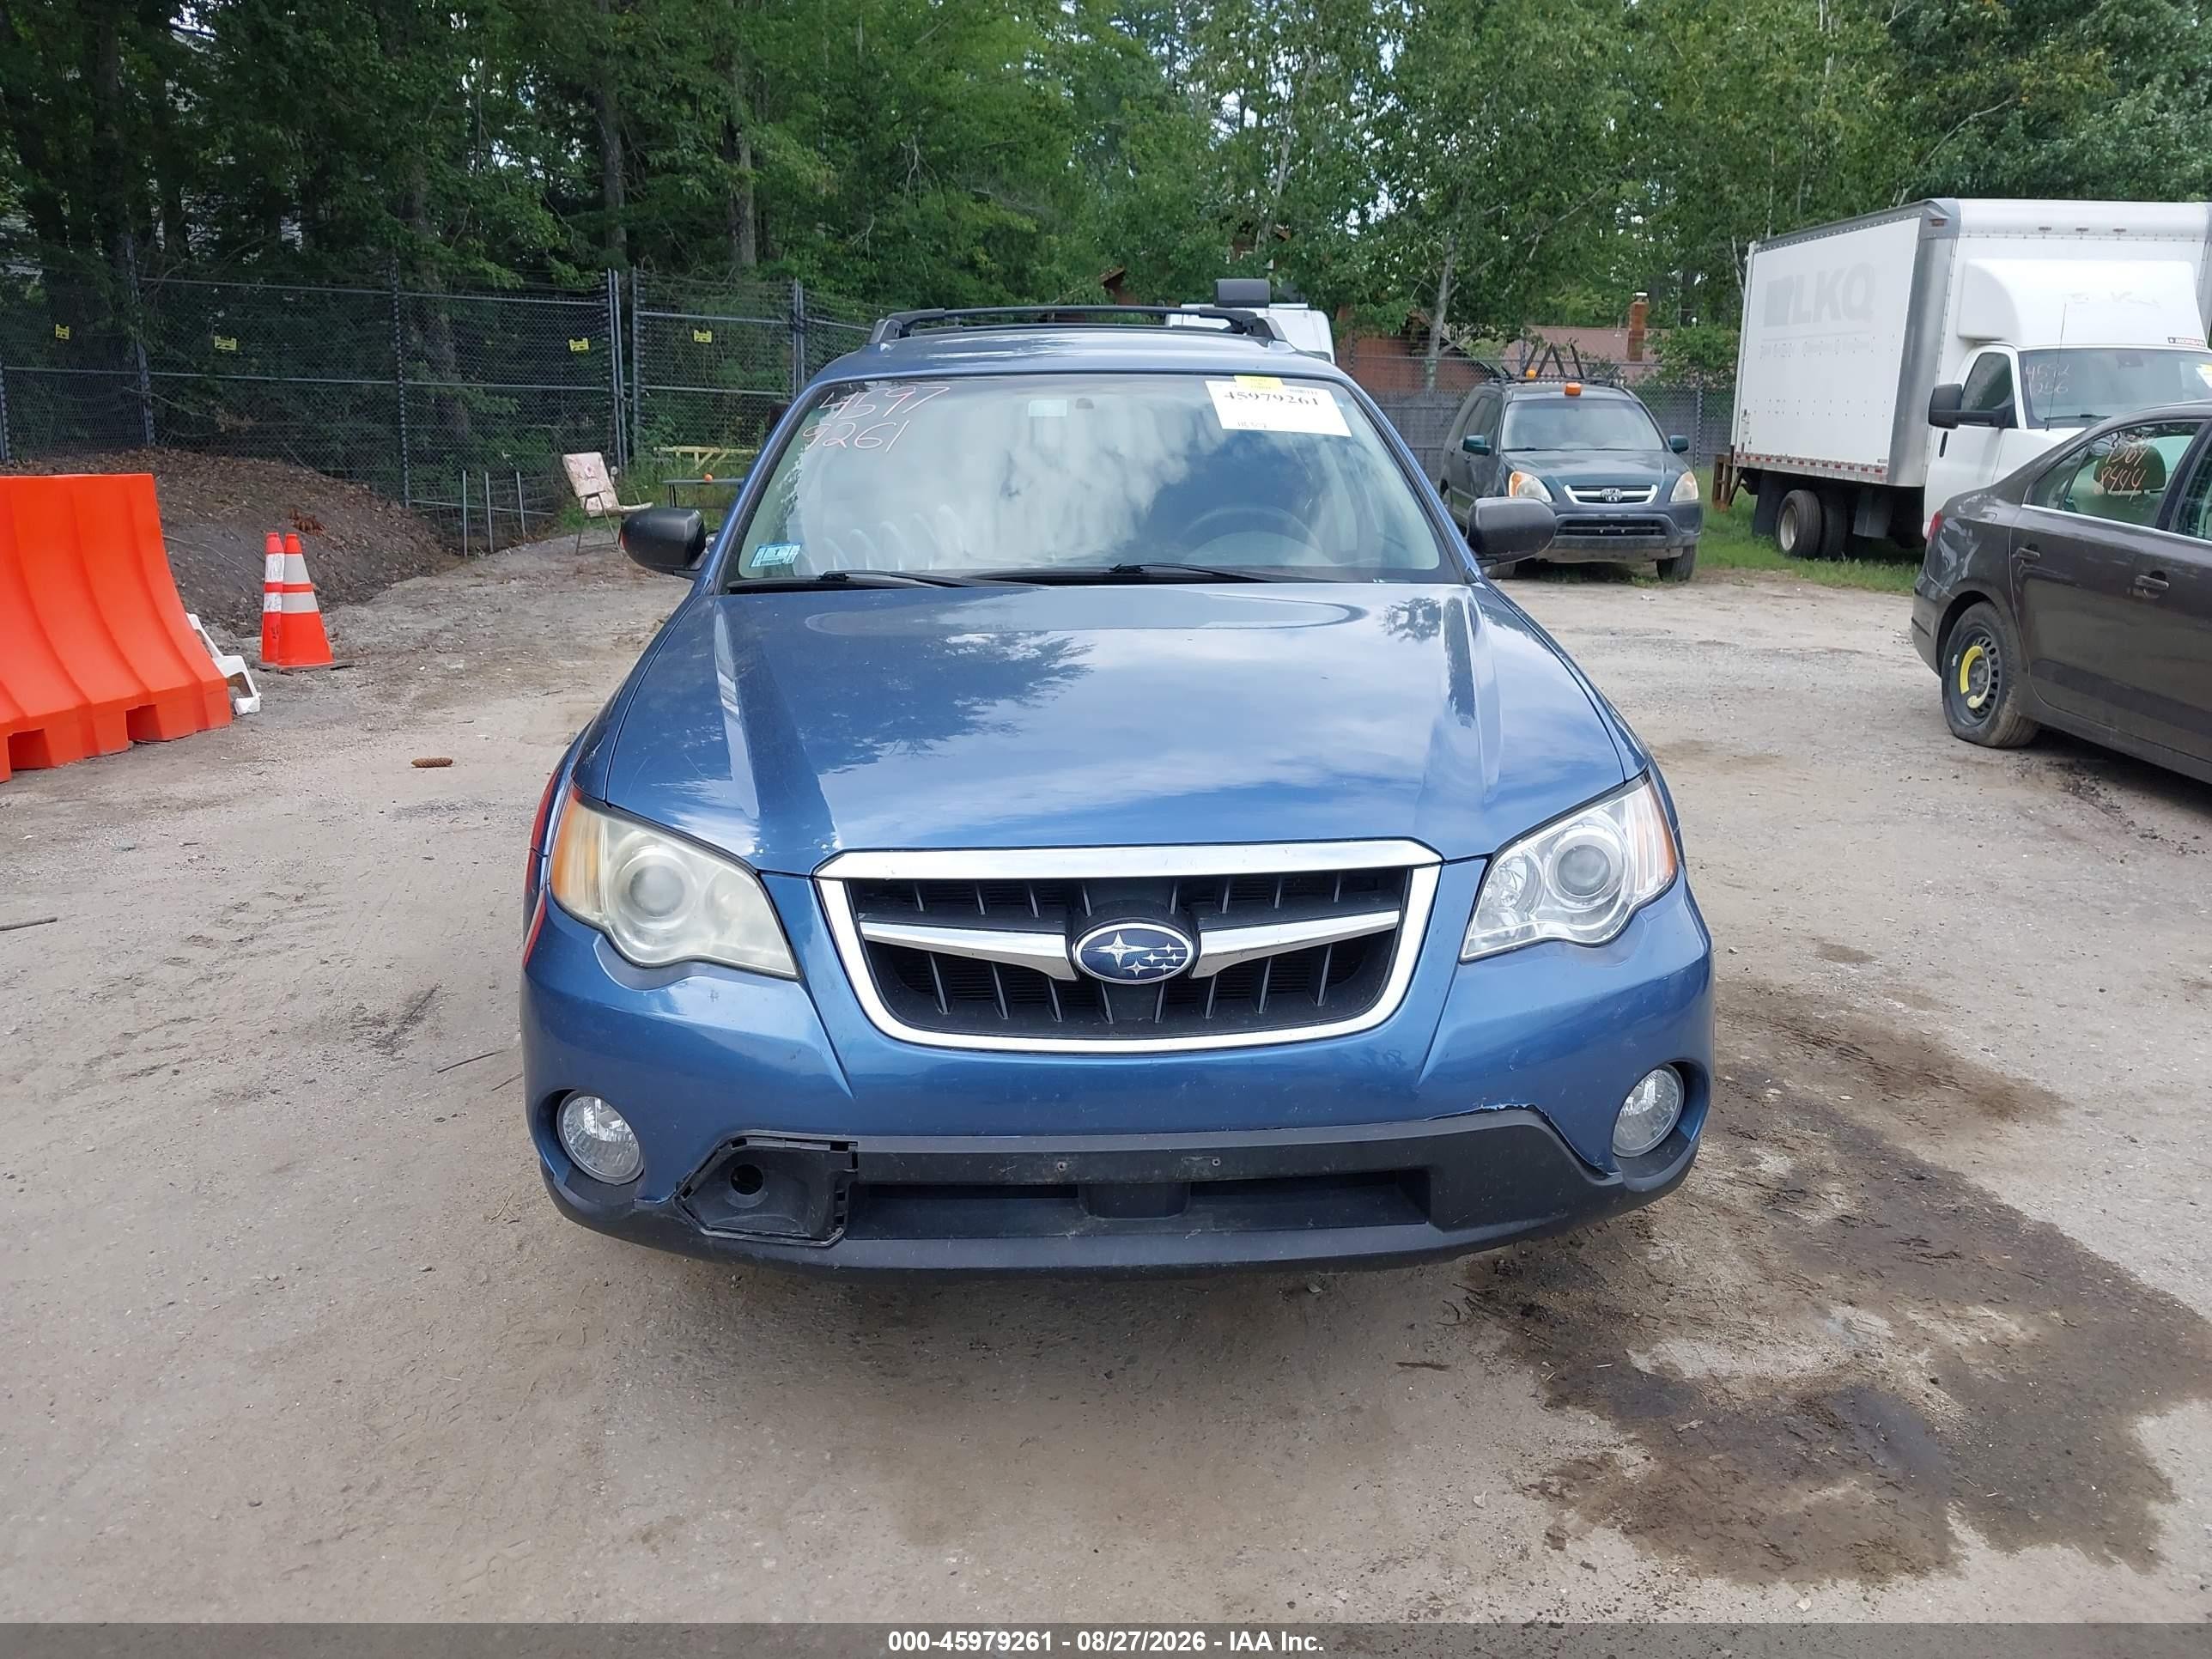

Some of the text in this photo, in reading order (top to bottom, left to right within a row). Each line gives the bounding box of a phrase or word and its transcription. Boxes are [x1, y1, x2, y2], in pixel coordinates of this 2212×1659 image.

[1791, 262, 1875, 325] LKQ
[818, 386, 951, 420] 4597
[1224, 392, 1319, 406] 45979261
[802, 419, 911, 453] 9261
